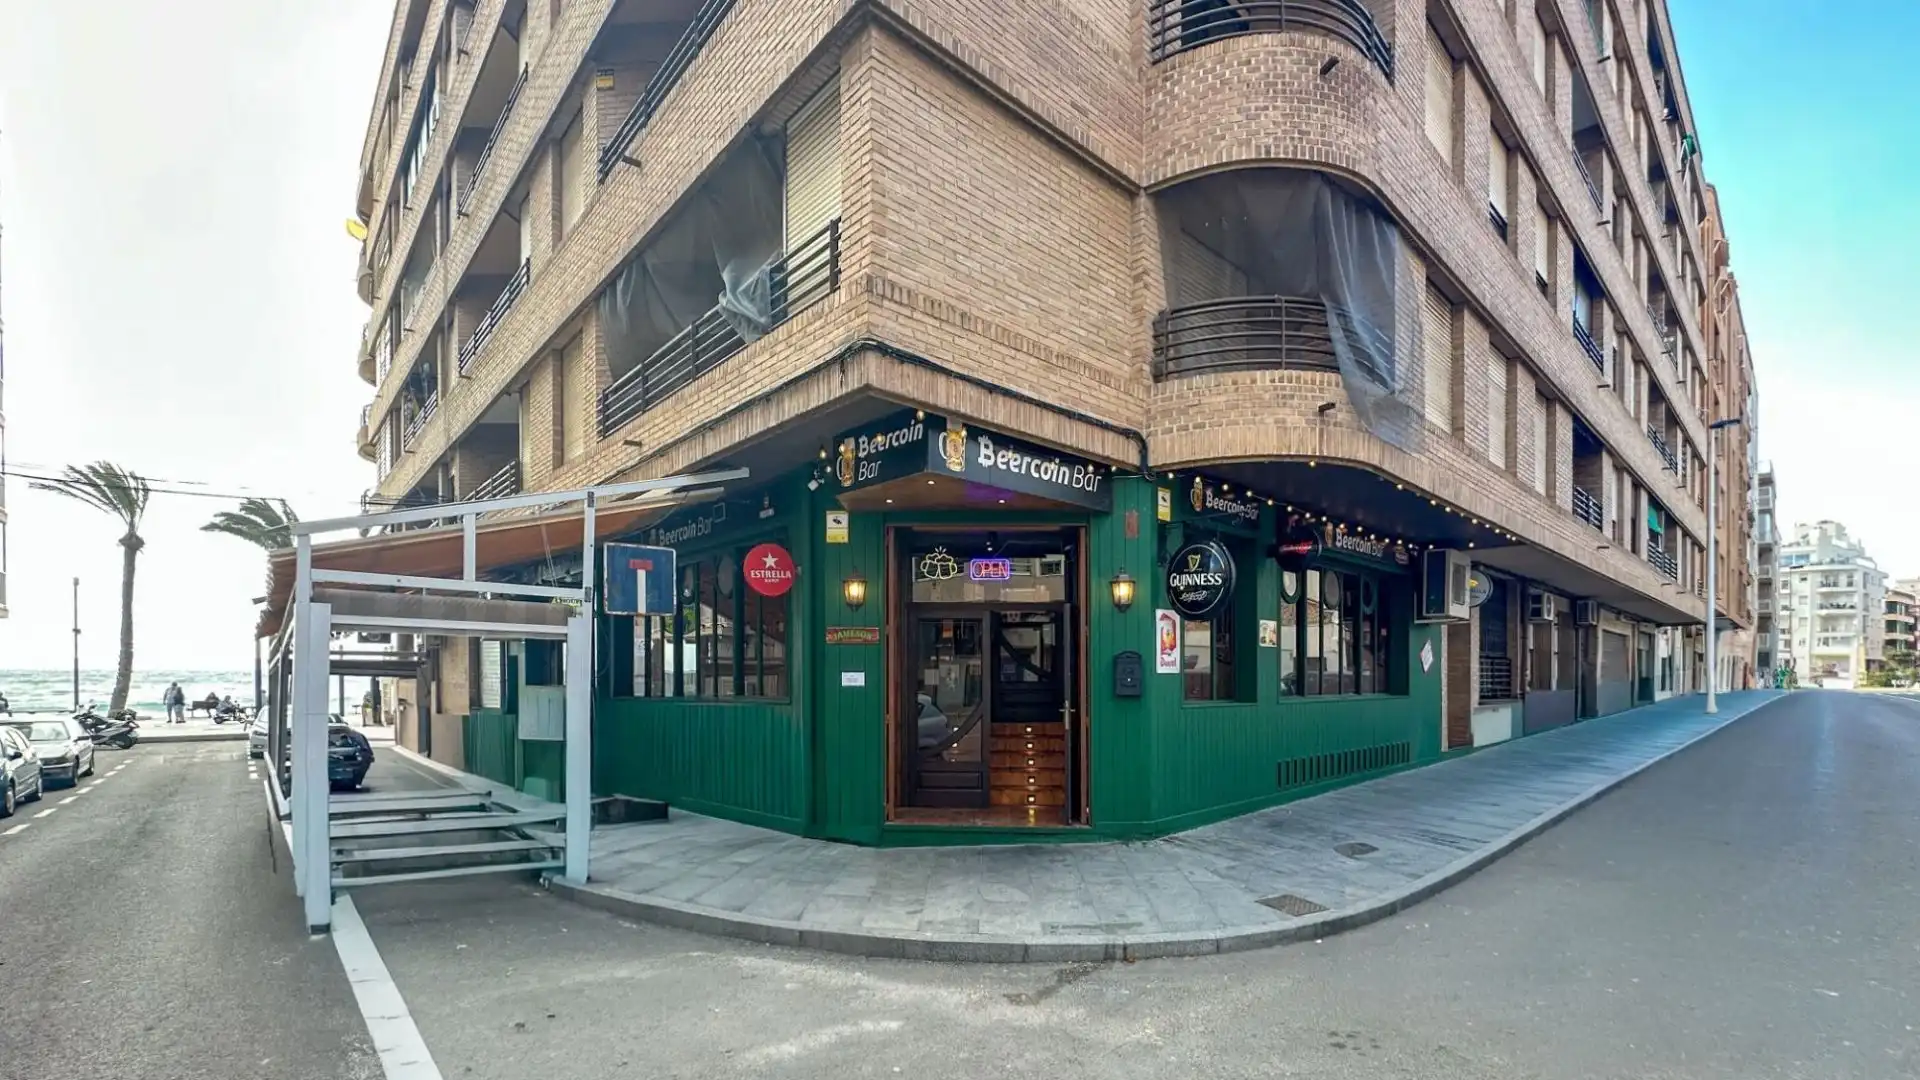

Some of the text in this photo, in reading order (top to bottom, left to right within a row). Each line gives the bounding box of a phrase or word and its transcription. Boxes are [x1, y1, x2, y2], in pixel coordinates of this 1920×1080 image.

[858, 419, 923, 458] Beercoin
[858, 458, 882, 482] Bar
[977, 435, 1103, 493] Beercoin Bar
[658, 516, 713, 546] Beercoin Bar
[1335, 527, 1372, 554] Beercoin
[750, 569, 792, 579] ESTRELLA
[973, 561, 1008, 577] OPEN
[1169, 573, 1223, 587] GUINNESS
[833, 629, 873, 640] JAMESON
